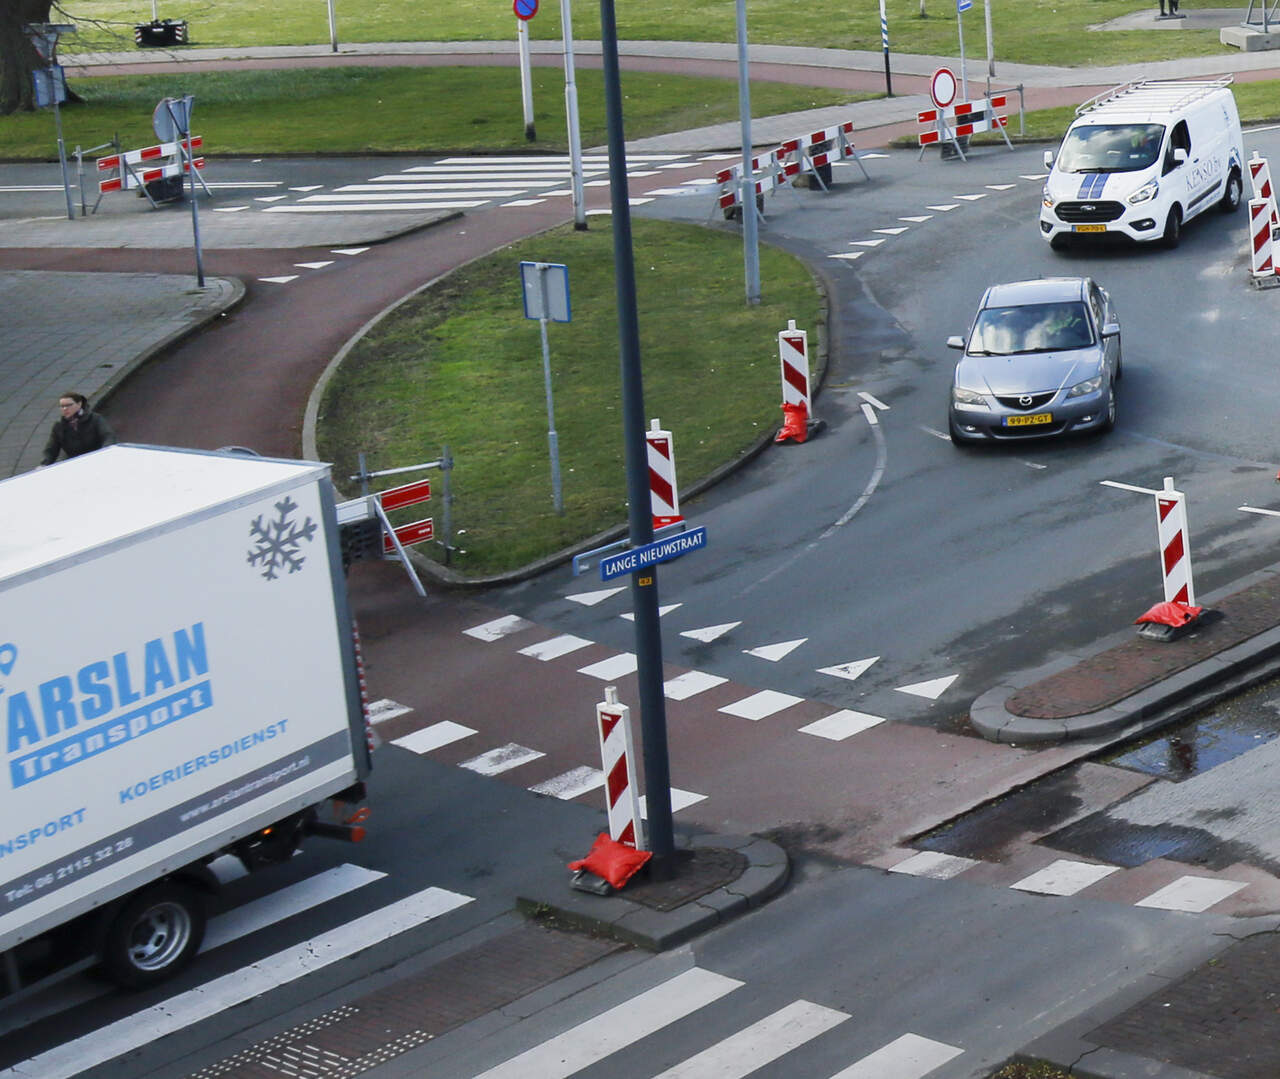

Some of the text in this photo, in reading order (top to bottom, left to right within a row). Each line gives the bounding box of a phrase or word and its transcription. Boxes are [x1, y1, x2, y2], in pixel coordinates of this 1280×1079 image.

[606, 532, 704, 576] LANGE NIEUWSTRAAT
[7, 622, 209, 753] ARSLAN
[19, 689, 205, 779] Transport
[118, 719, 289, 804] KOERIERSDIENST
